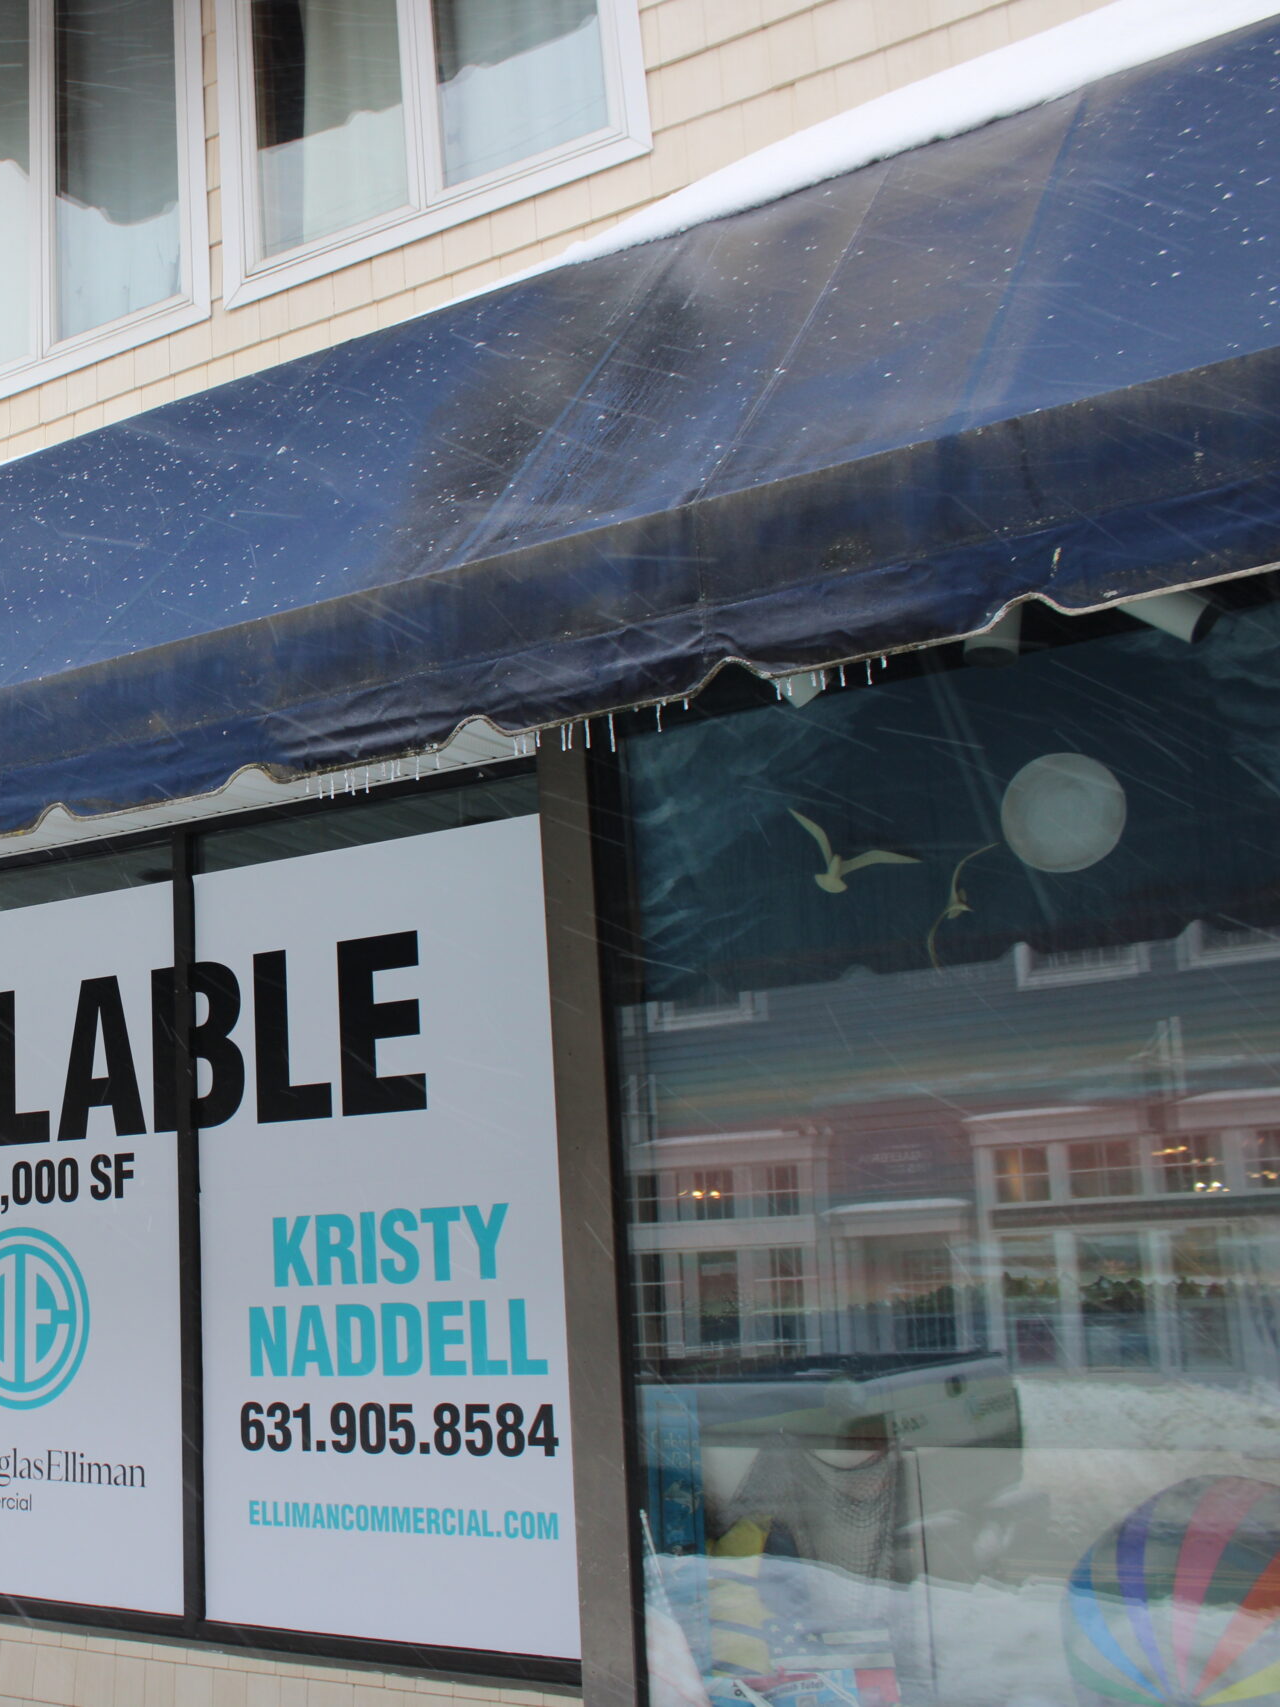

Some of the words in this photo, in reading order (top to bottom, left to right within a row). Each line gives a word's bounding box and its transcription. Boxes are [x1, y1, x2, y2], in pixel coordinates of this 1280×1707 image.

[90, 1152, 136, 1201] SF
[272, 1203, 509, 1287] KRISTY
[248, 1298, 548, 1377] NADDELL
[240, 1401, 560, 1458] 631.905.8584
[248, 1500, 560, 1541] ELLIMANCOMMERCIAL.COM
